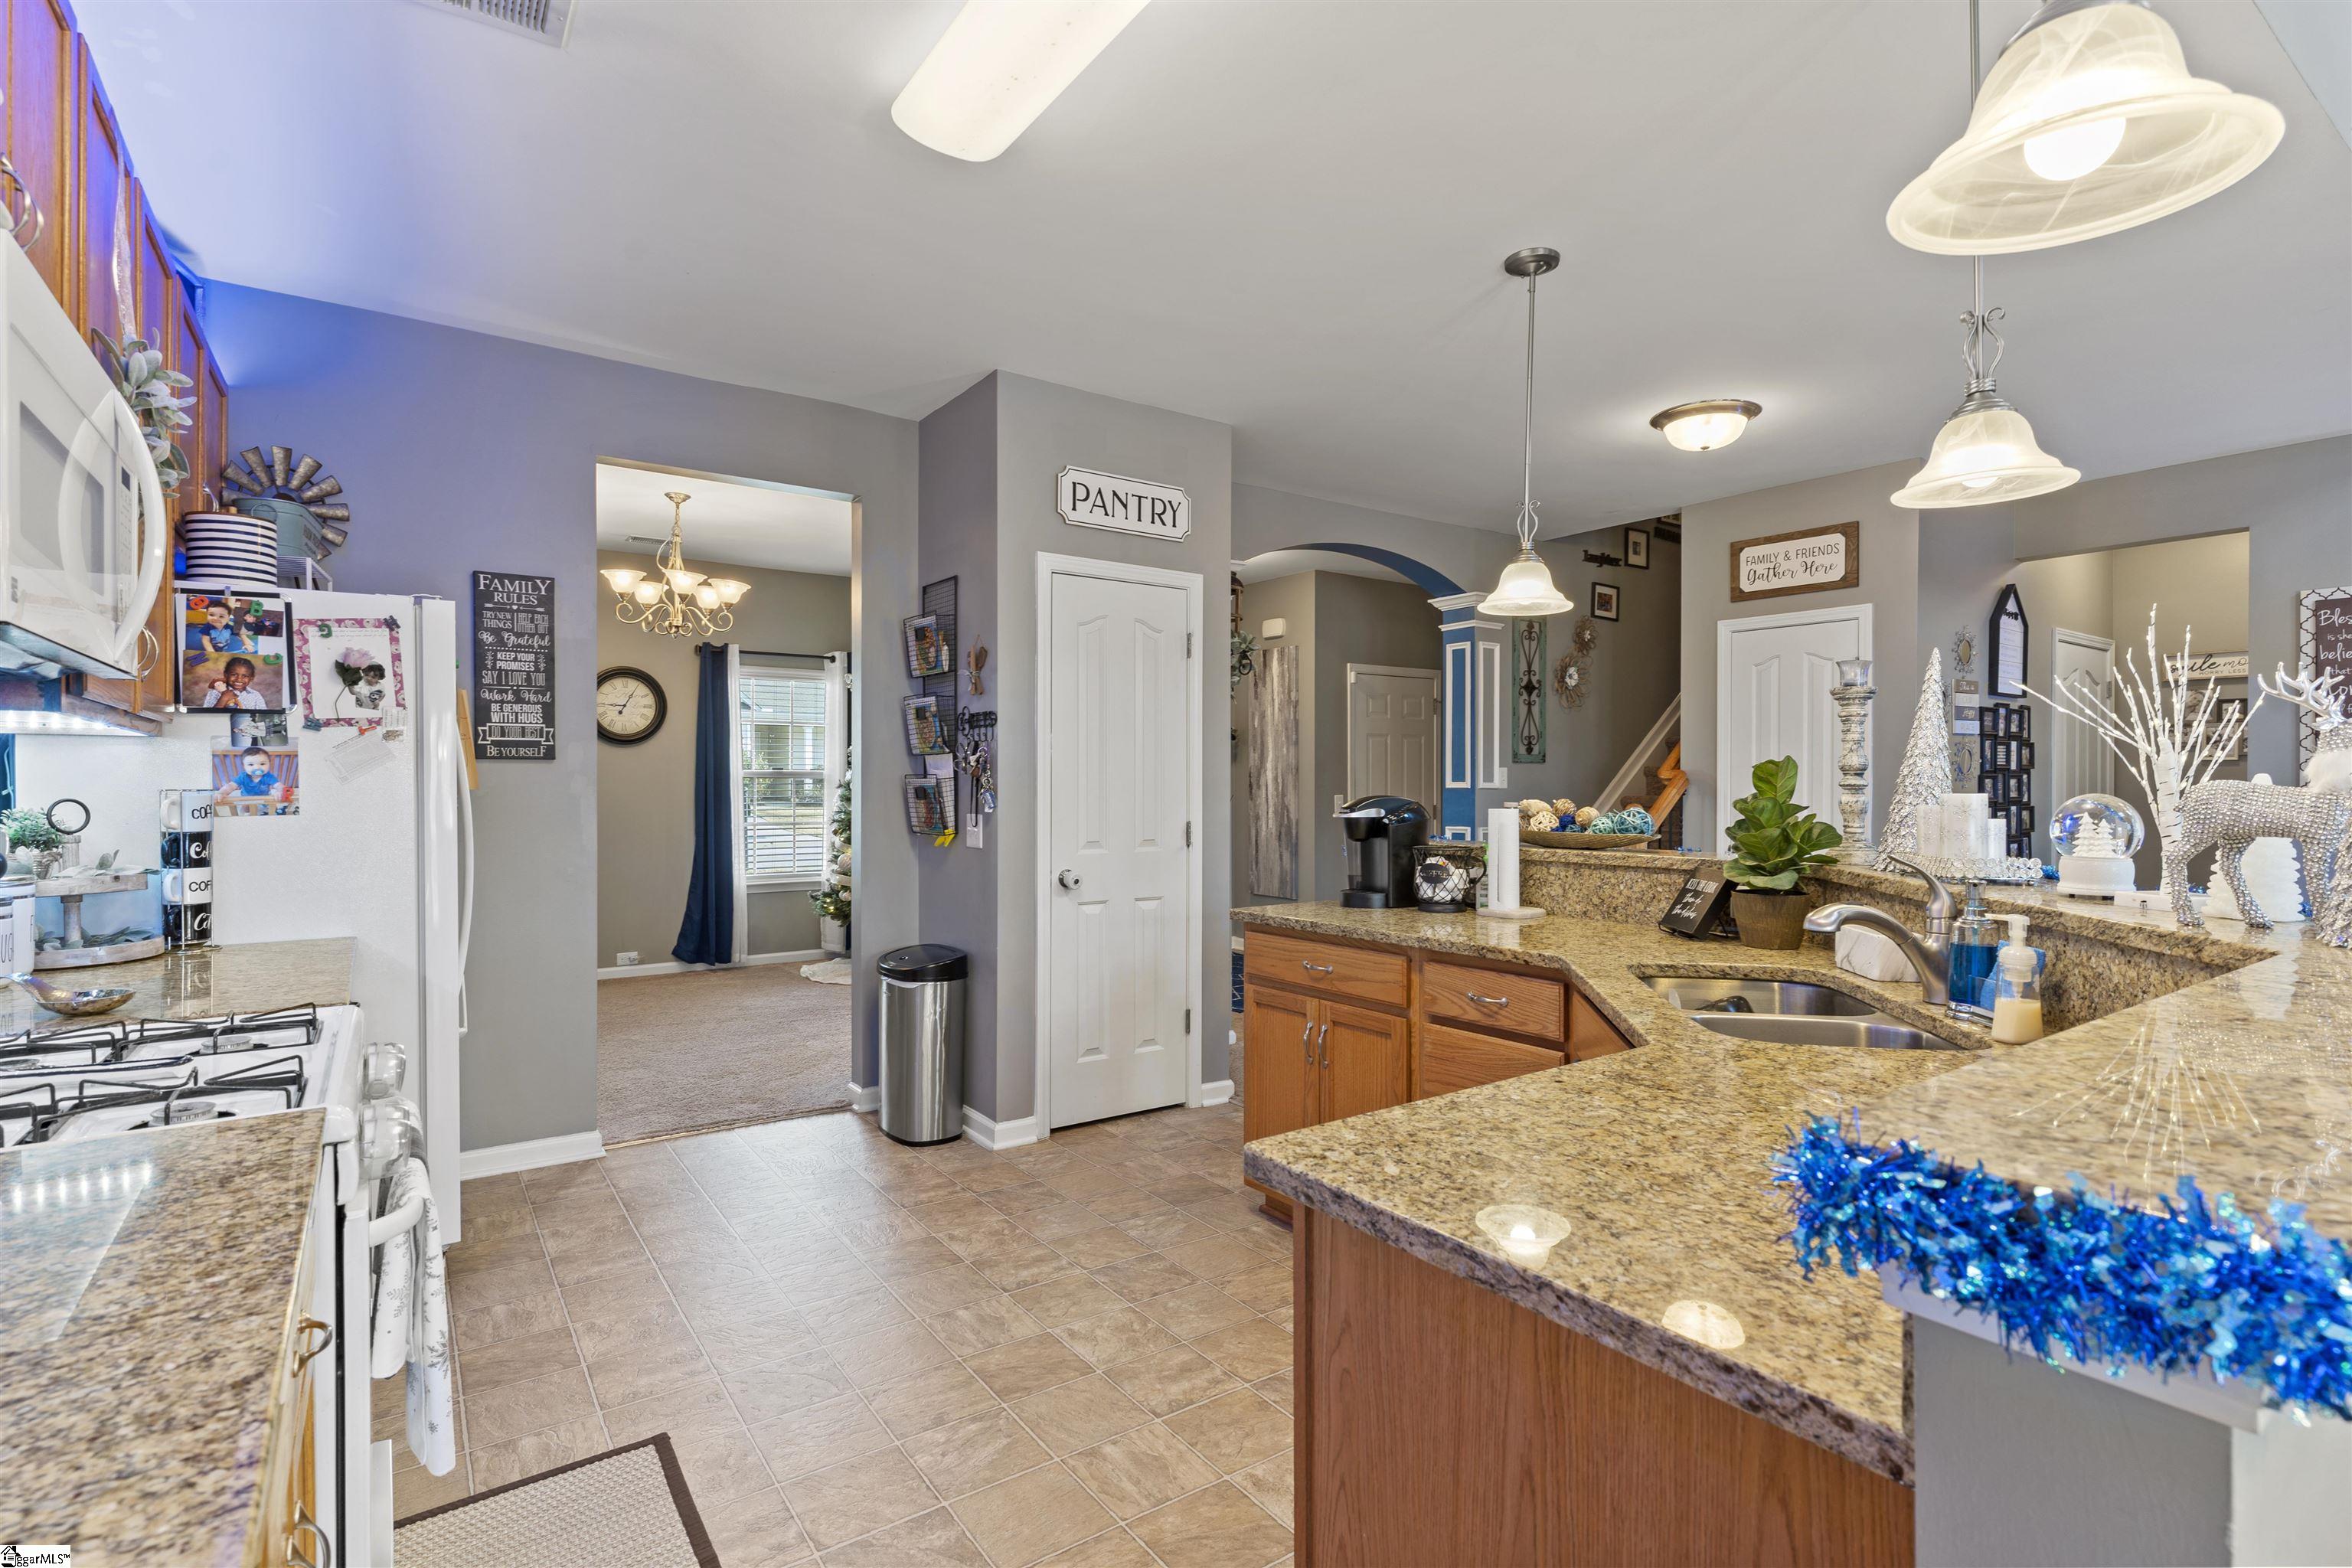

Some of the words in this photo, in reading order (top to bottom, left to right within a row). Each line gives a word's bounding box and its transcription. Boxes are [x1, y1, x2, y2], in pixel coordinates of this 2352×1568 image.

[1071, 481, 1181, 528] PANTRY
[1746, 552, 1780, 567] FAMILY
[1783, 550, 1792, 561] &
[1795, 543, 1840, 560] FRIENDS
[1746, 562, 1798, 586] Gather
[1800, 560, 1838, 577] Here
[478, 573, 551, 596] FAMILY
[493, 592, 537, 605] RULES
[482, 610, 496, 619] TRY
[496, 611, 513, 619] NEW
[518, 612, 532, 623] HELP
[534, 613, 549, 625] EACH
[482, 619, 512, 629] THINGS
[478, 630, 497, 644] Be
[501, 630, 551, 649] Grateful
[497, 652, 515, 661] KEEP
[516, 652, 535, 662] YOUR
[2319, 642, 2352, 662] belie
[496, 661, 534, 671] PROMISES
[482, 670, 498, 684] SAY
[501, 671, 505, 684] I
[508, 671, 527, 685] LOVE
[530, 672, 545, 686] YOU
[480, 688, 517, 702] Work
[521, 689, 552, 704] Hard
[491, 703, 501, 712] BE
[502, 704, 543, 713] GENEROUS
[491, 711, 515, 723] WITH
[518, 713, 543, 724] HUGS
[492, 726, 501, 738] DO
[504, 726, 522, 738] YOUR
[525, 727, 541, 739] BEST
[486, 745, 500, 756] BE
[501, 746, 547, 757] YOURSELF
